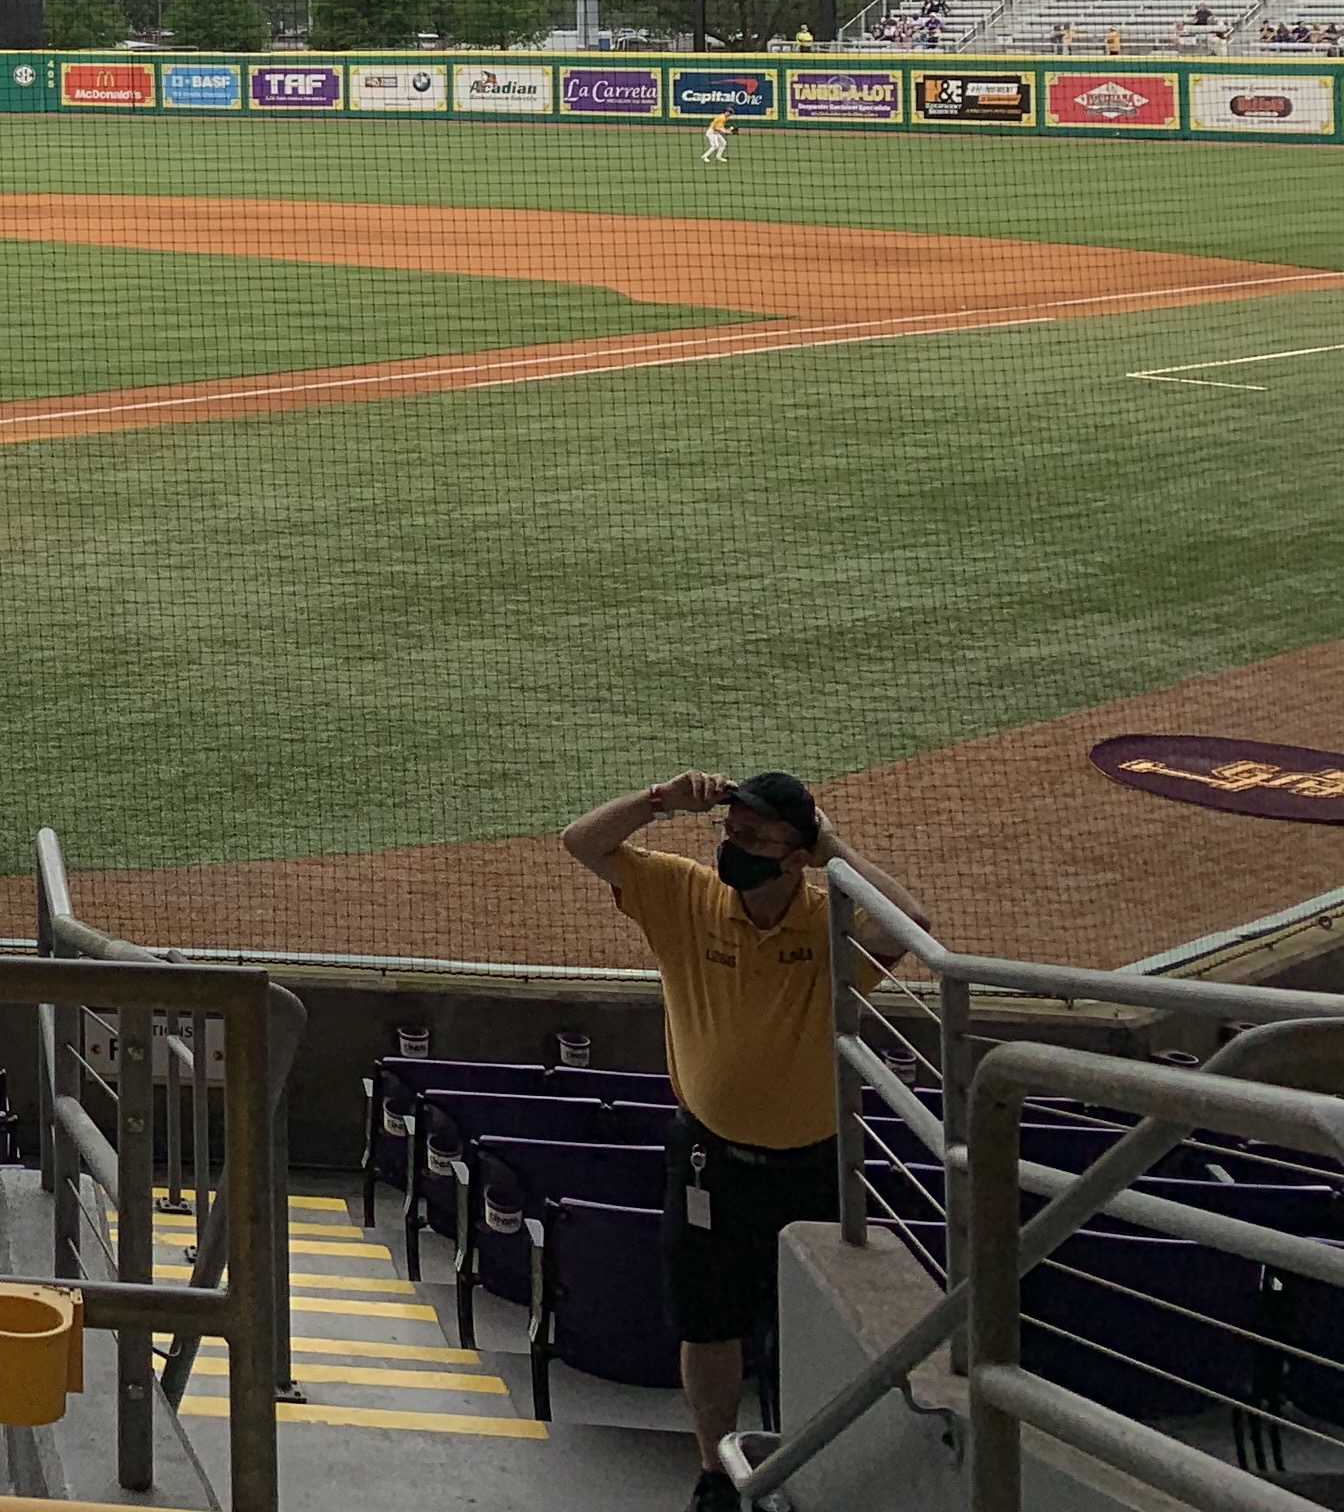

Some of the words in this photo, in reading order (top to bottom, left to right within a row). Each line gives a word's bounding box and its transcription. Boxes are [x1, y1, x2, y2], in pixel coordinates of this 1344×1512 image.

[192, 76, 230, 88] BASF
[265, 74, 326, 95] TAF
[469, 81, 537, 95] Acadian
[75, 89, 141, 100] McDonald's
[563, 79, 589, 101] La
[592, 80, 657, 103] Carreta
[925, 79, 962, 103] H&E
